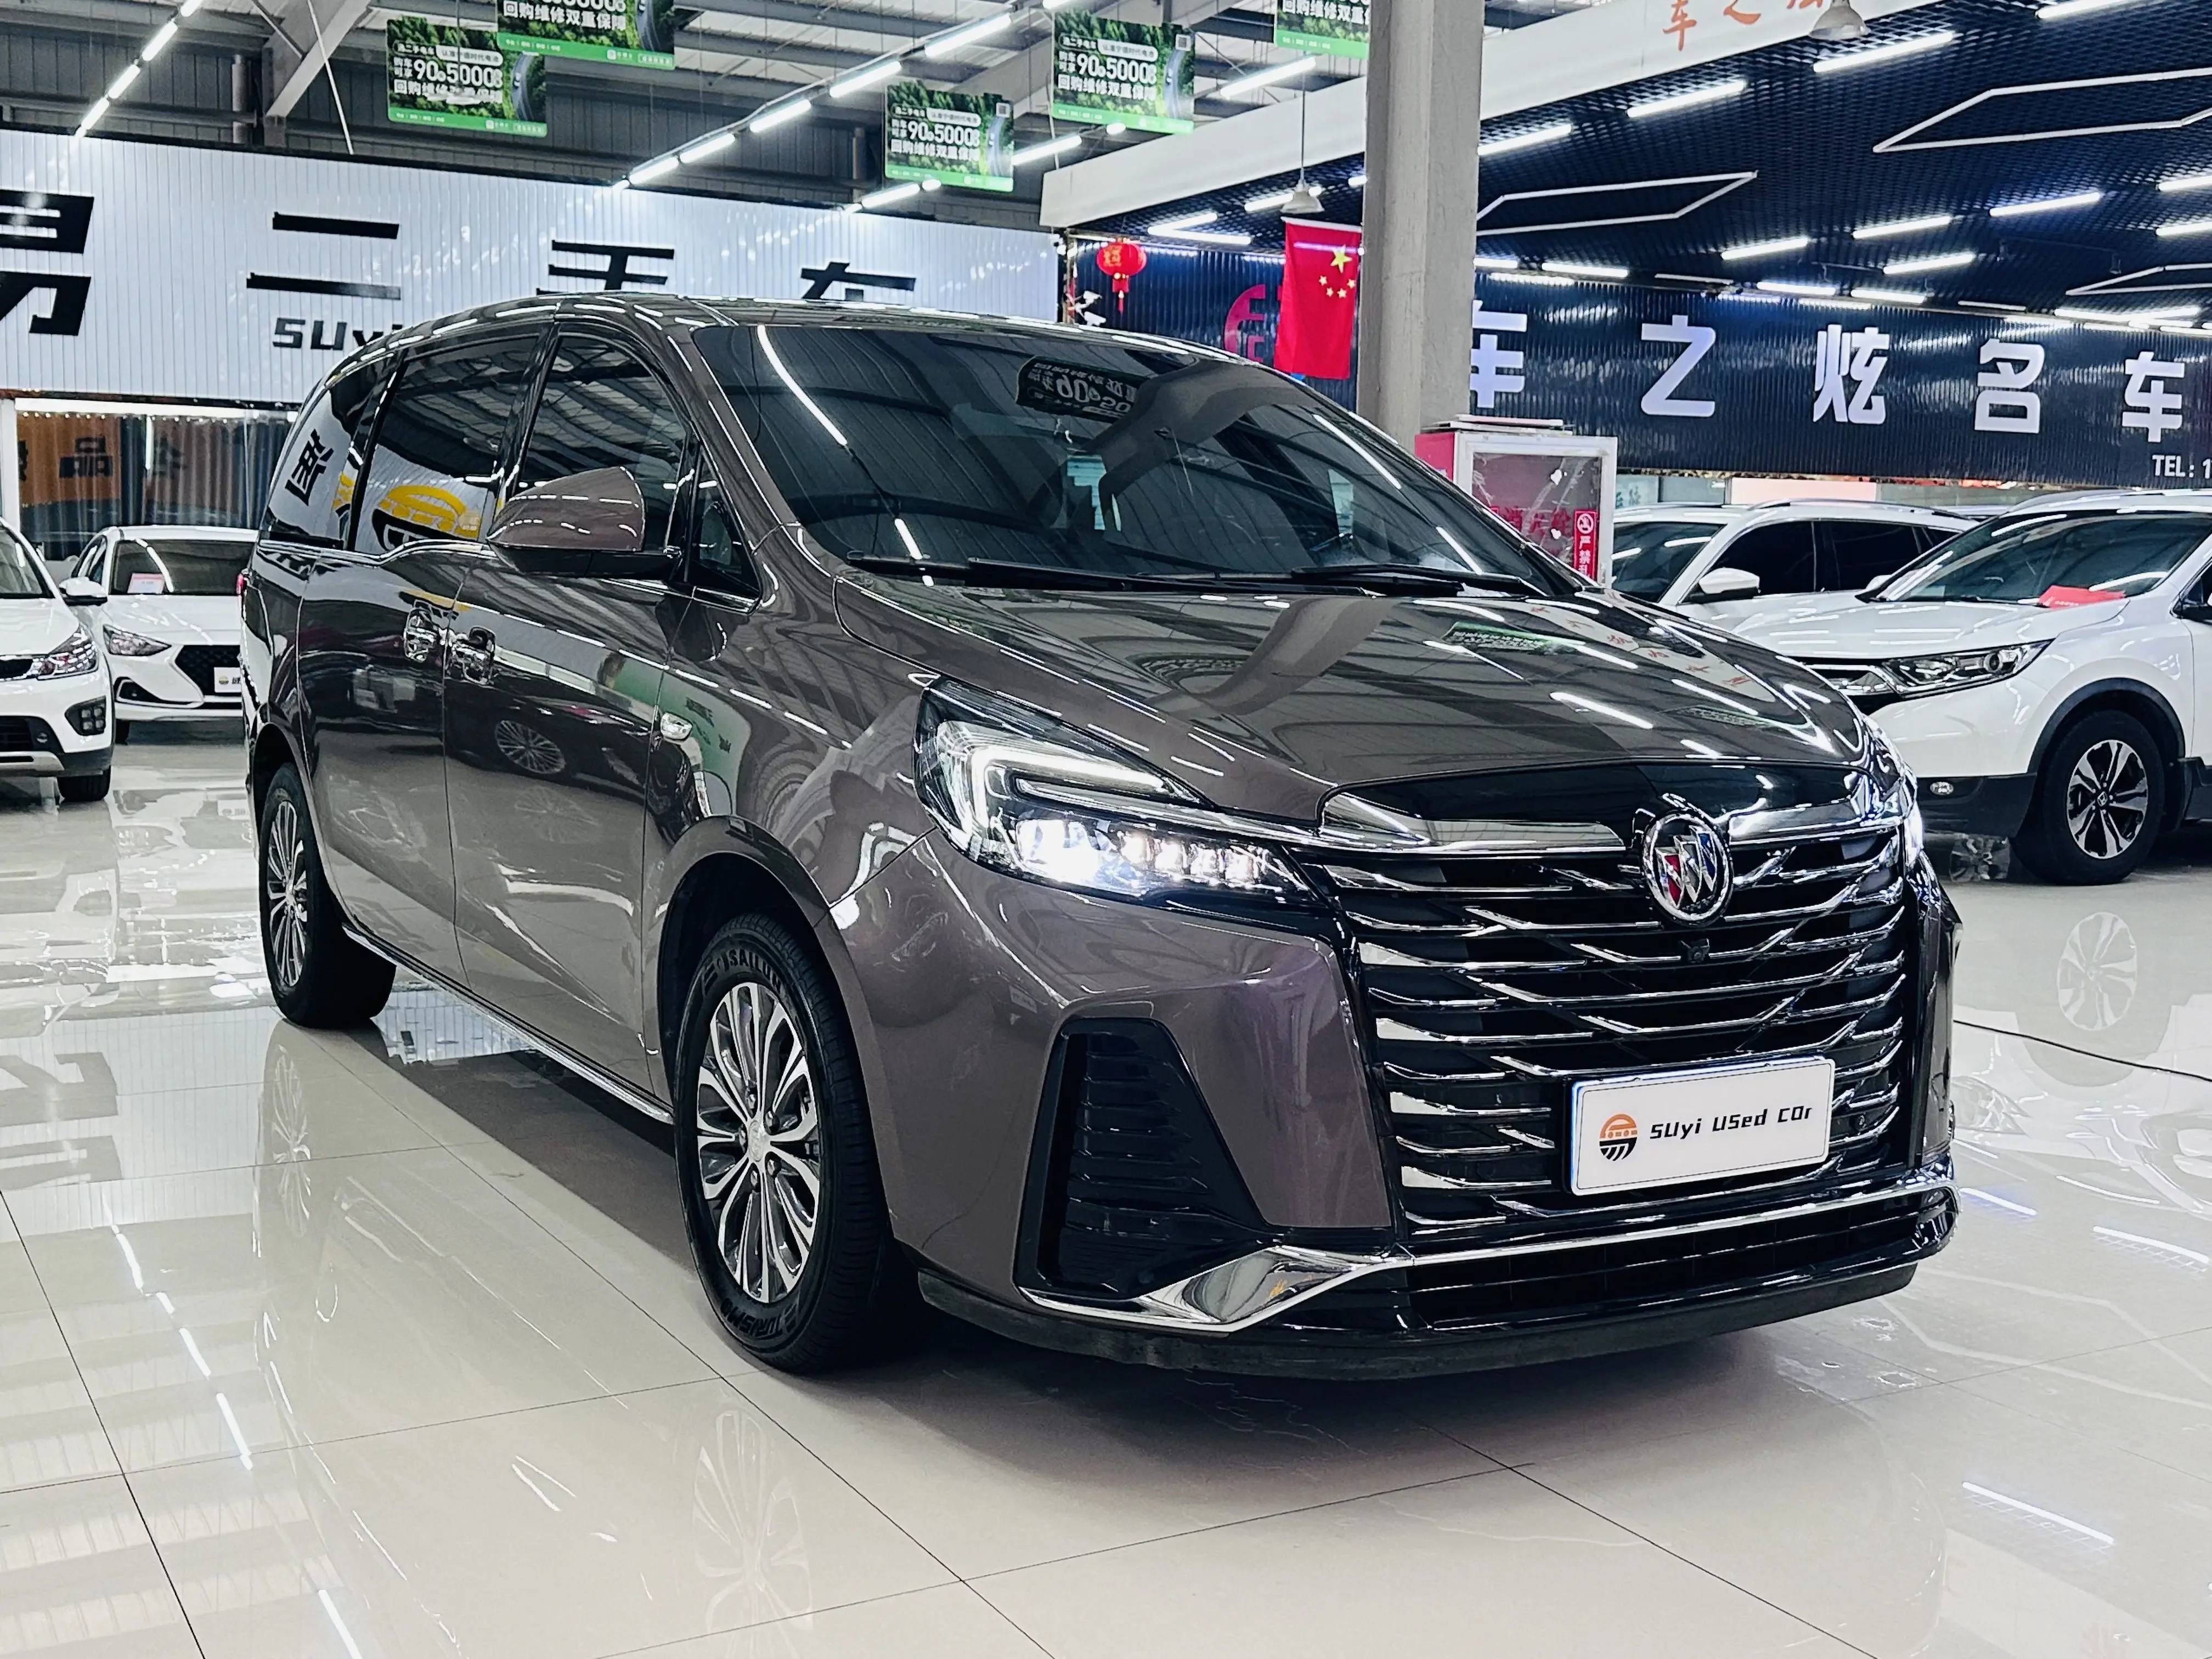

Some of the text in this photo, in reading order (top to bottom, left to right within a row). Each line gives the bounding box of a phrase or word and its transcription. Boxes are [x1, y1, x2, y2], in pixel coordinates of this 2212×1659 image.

[504, 1, 625, 30] 回购维修双重保障
[1283, 0, 1370, 25] 回购维修双重
[1058, 74, 1156, 100] 回购维修双重保障
[2152, 454, 2194, 478] TEL:
